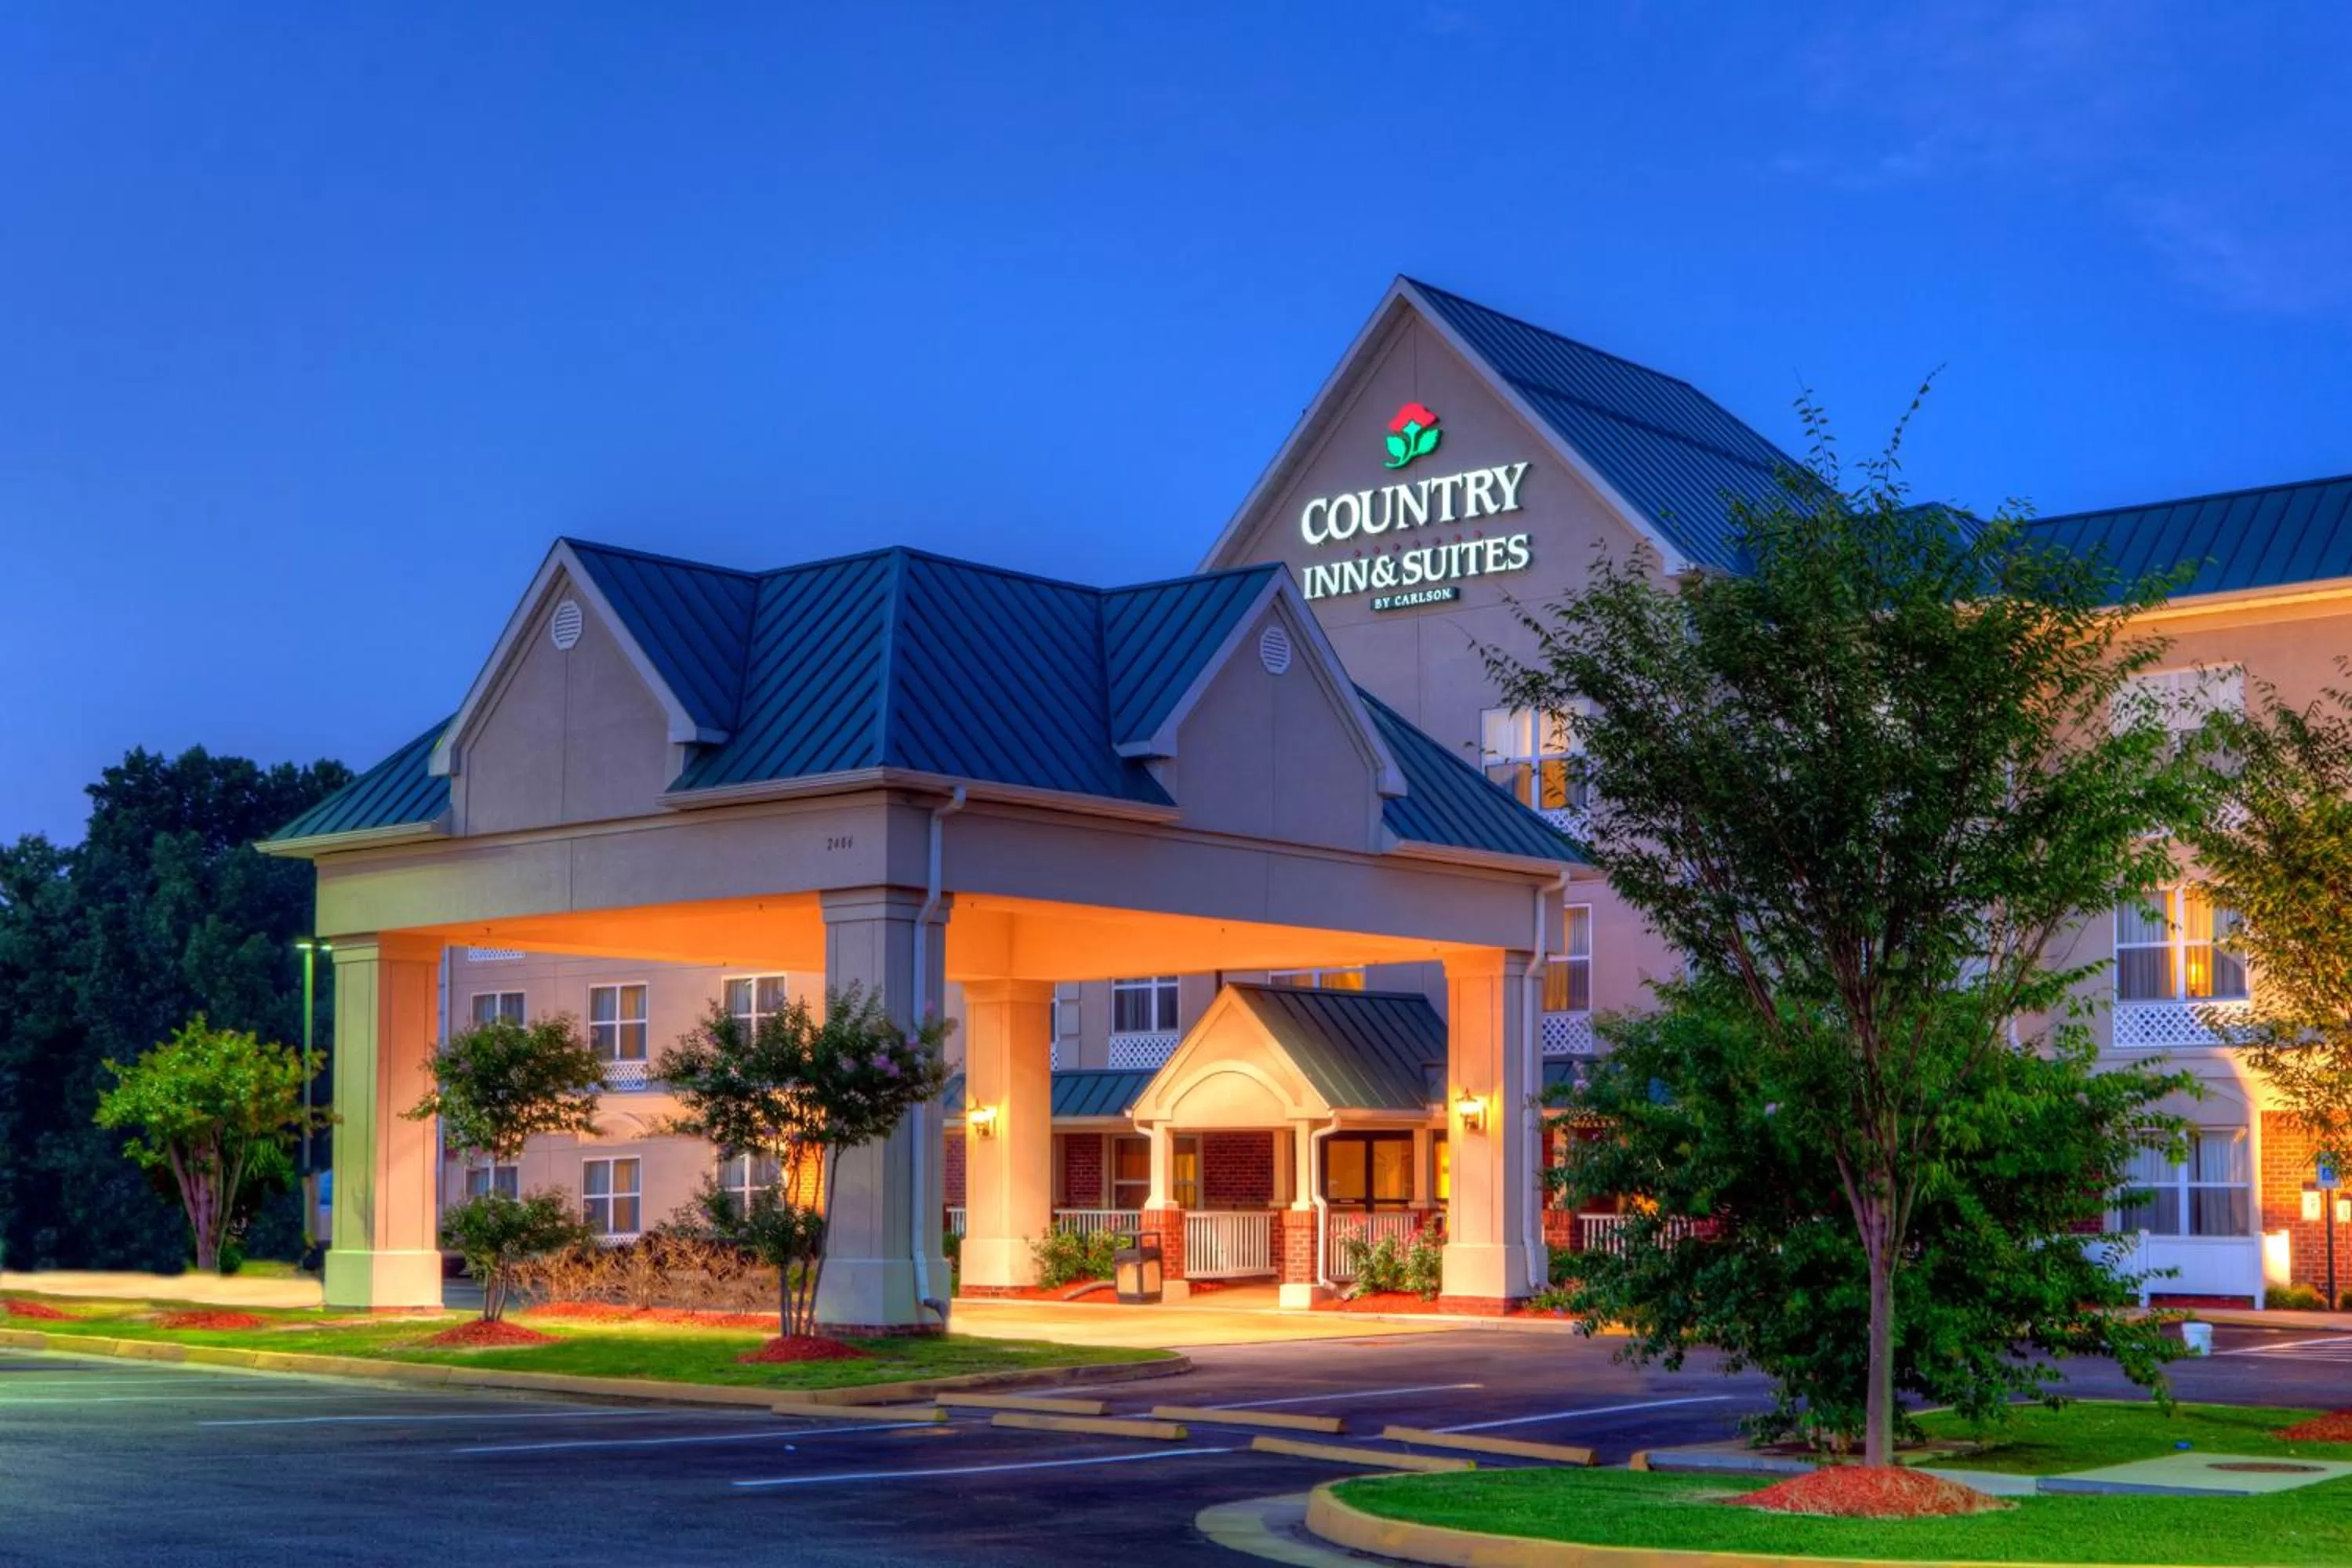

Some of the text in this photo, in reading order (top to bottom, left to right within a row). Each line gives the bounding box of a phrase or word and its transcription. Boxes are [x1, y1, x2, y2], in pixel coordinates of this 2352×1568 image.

[1301, 462, 1530, 545] COUNTRY
[1374, 587, 1451, 609] BY CARLSON
